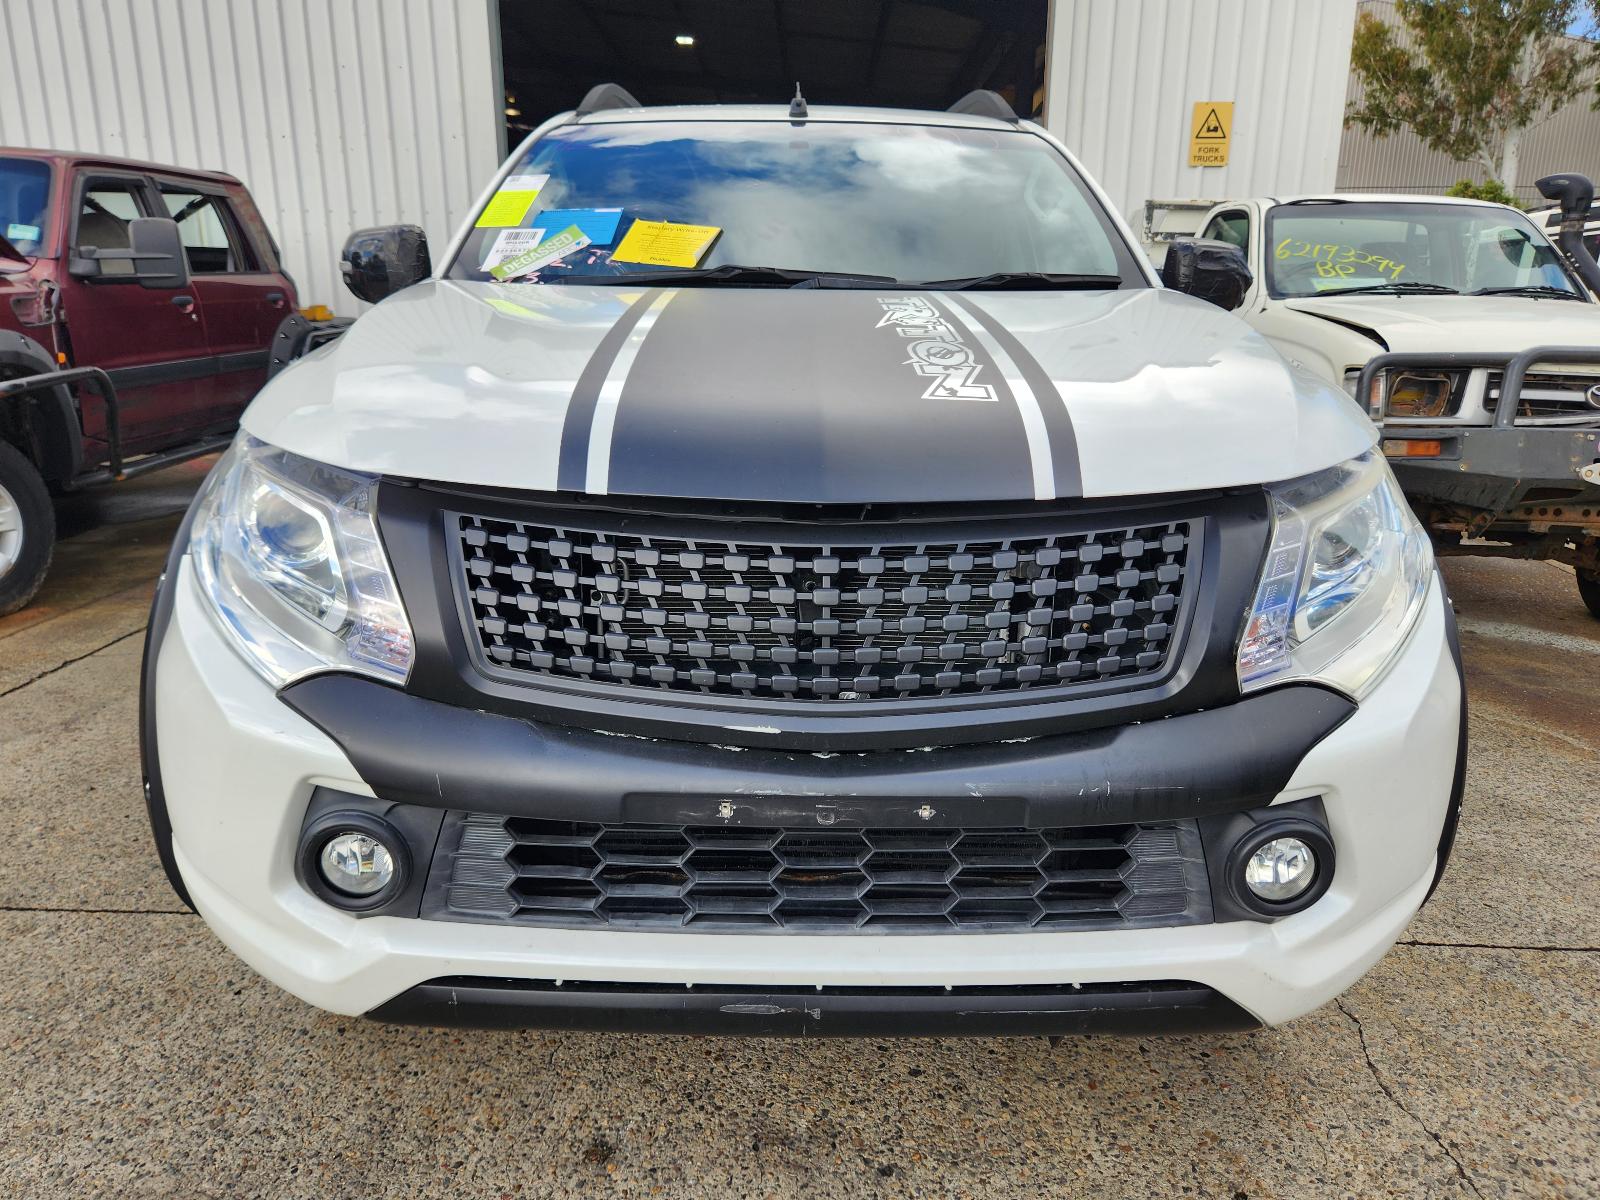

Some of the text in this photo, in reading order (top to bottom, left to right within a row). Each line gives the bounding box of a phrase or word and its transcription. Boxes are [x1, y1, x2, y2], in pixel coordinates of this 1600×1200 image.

[1197, 146, 1220, 154] FORK
[1193, 155, 1225, 163] TRUCKS
[502, 232, 573, 275] DEGASSED
